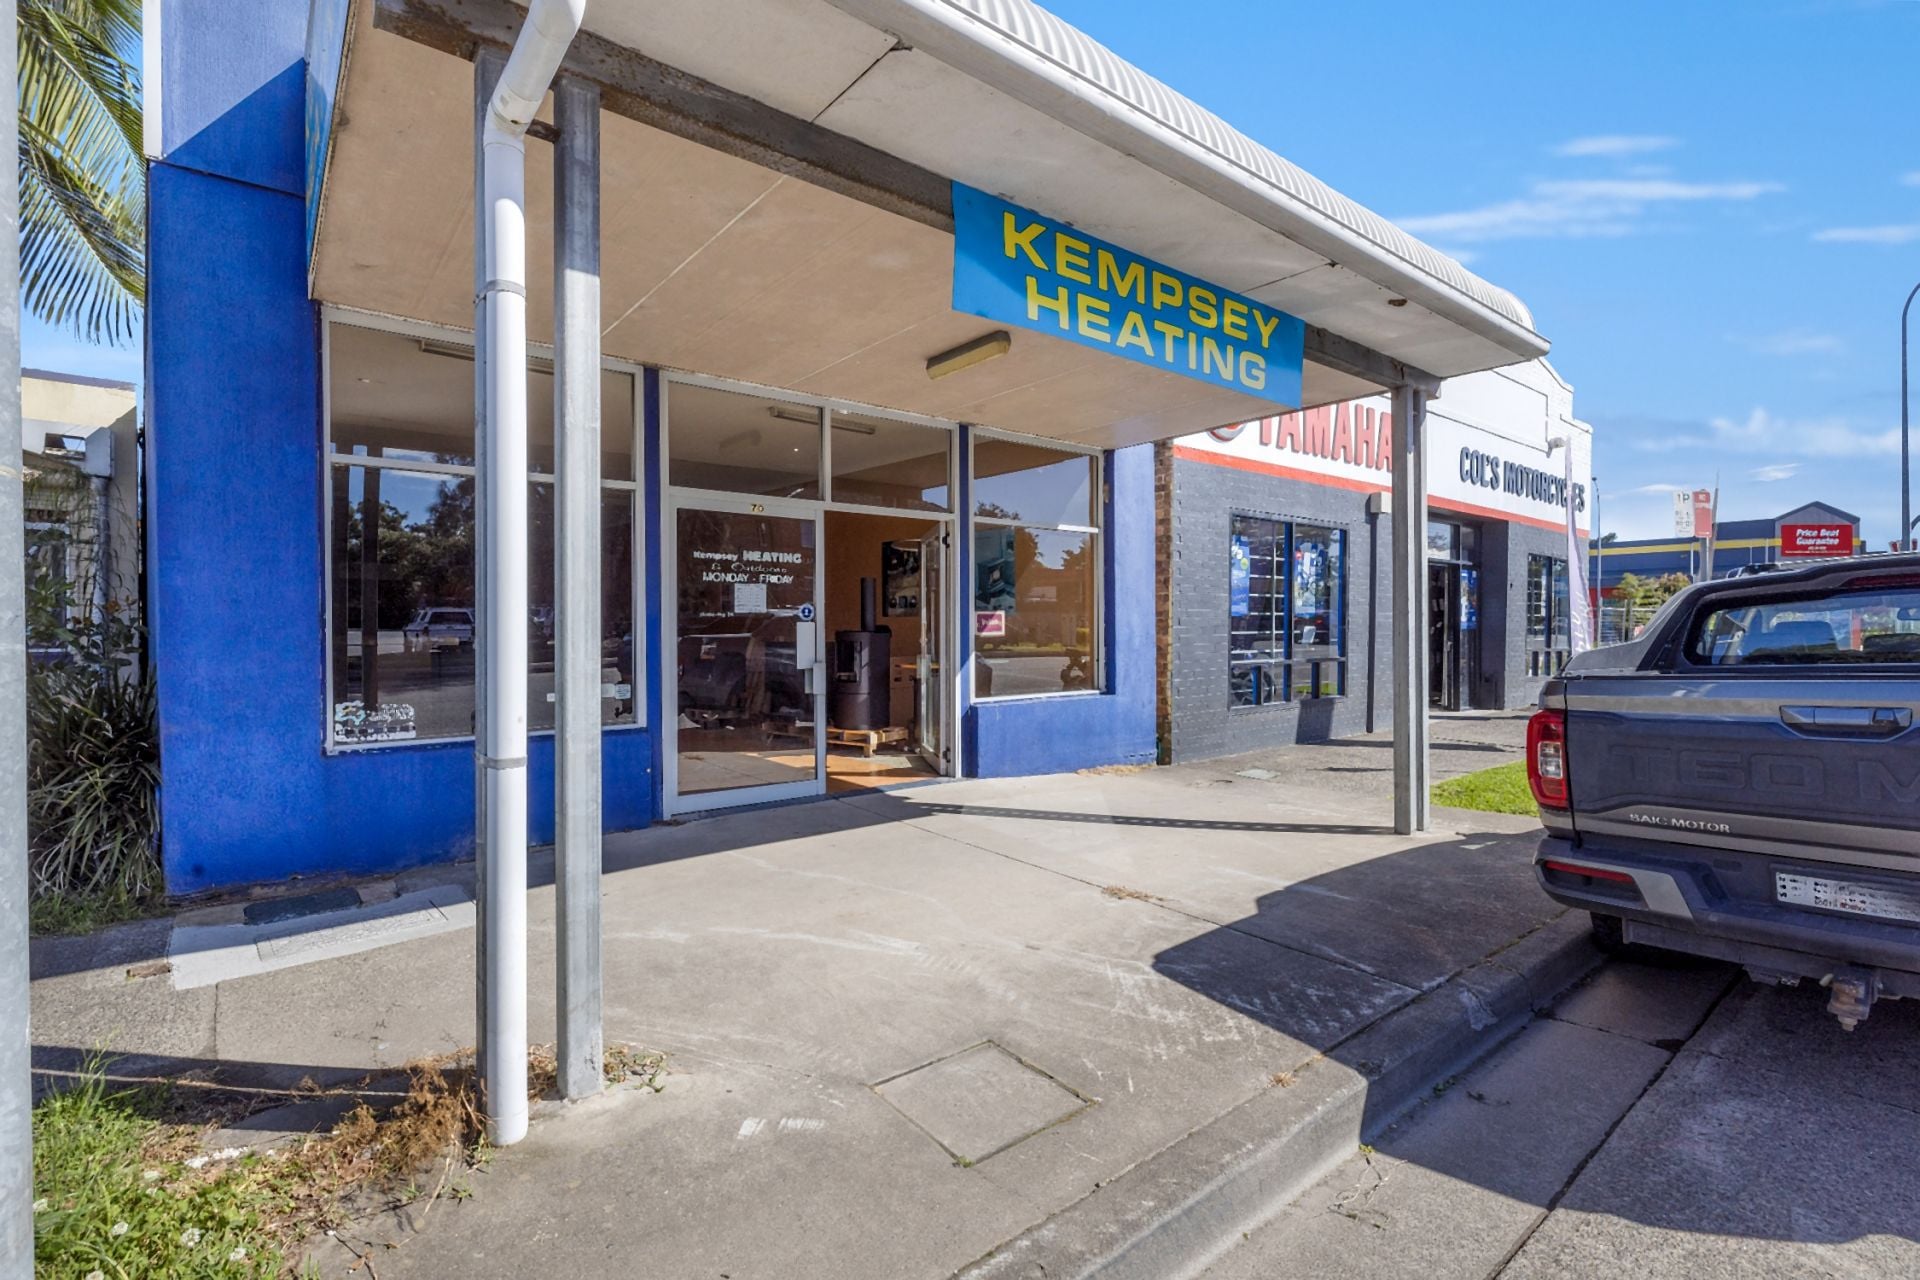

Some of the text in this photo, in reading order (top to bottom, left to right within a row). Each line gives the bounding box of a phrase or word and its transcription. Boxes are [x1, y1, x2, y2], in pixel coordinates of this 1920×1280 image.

[1003, 211, 1279, 348] KEMPSEY
[1026, 275, 1267, 390] HEATING
[1460, 446, 1585, 512] COL'S MOTORCYCES
[1796, 528, 1818, 537] Price
[693, 550, 802, 563] Kempsey HEATING
[702, 571, 749, 582] MONDAY
[759, 574, 793, 584] FRIDAY
[1629, 813, 1730, 833] SAIC MOTOR
